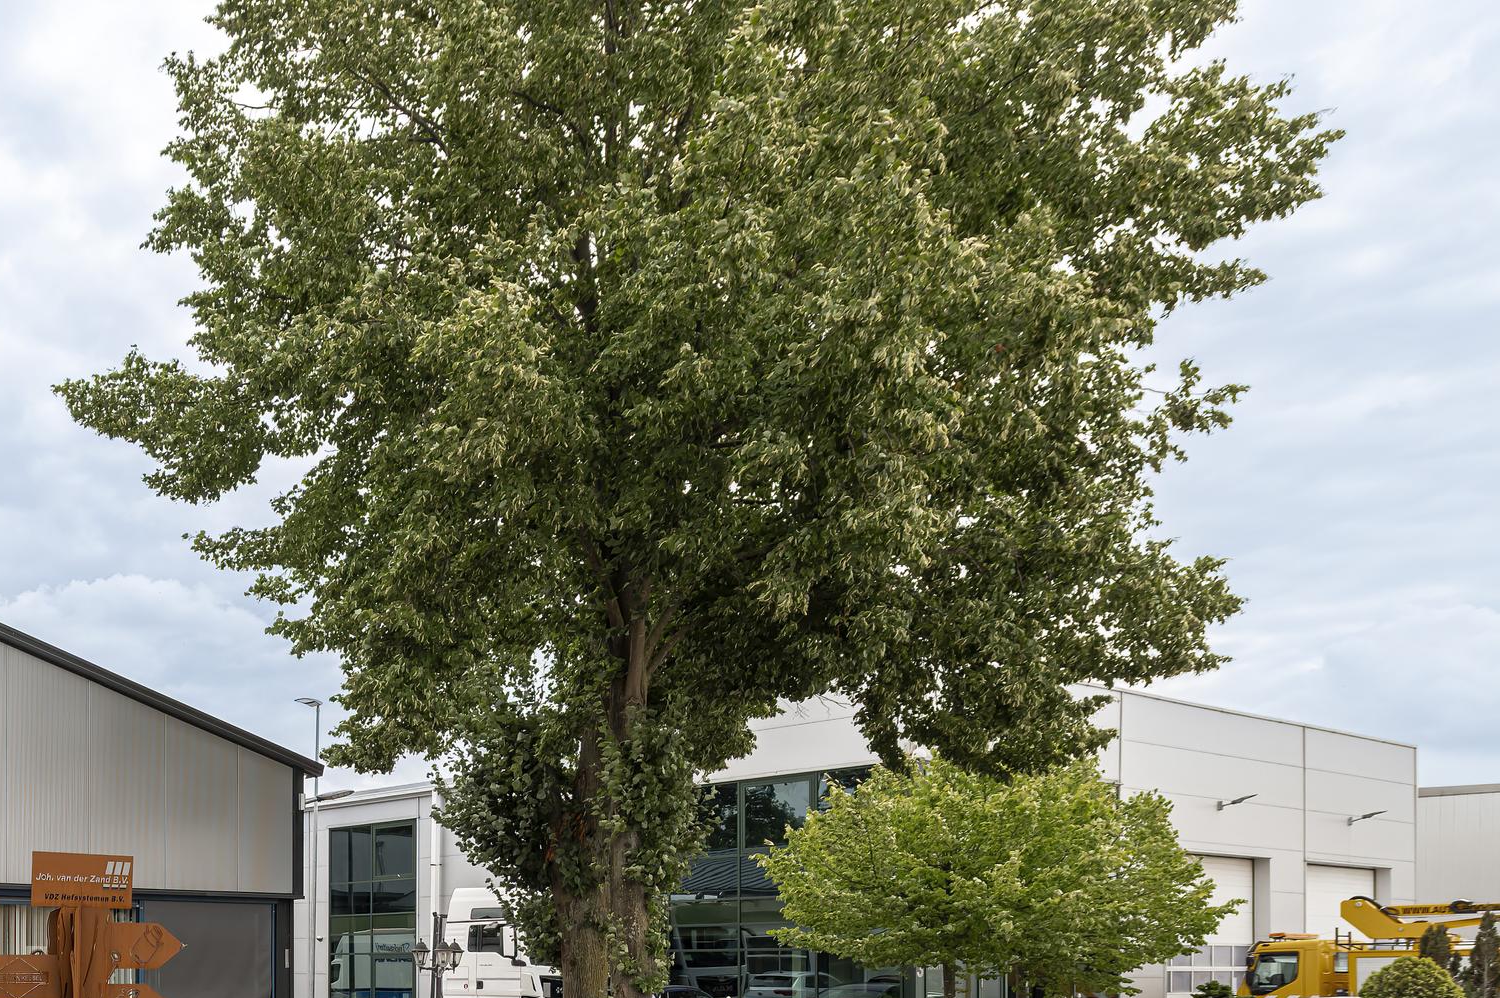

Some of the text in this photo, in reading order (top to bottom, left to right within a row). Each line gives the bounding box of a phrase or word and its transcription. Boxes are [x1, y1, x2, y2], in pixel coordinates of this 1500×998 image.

[35, 872, 54, 881] Joh.
[89, 875, 110, 884] Zand
[112, 876, 129, 884] B.V.
